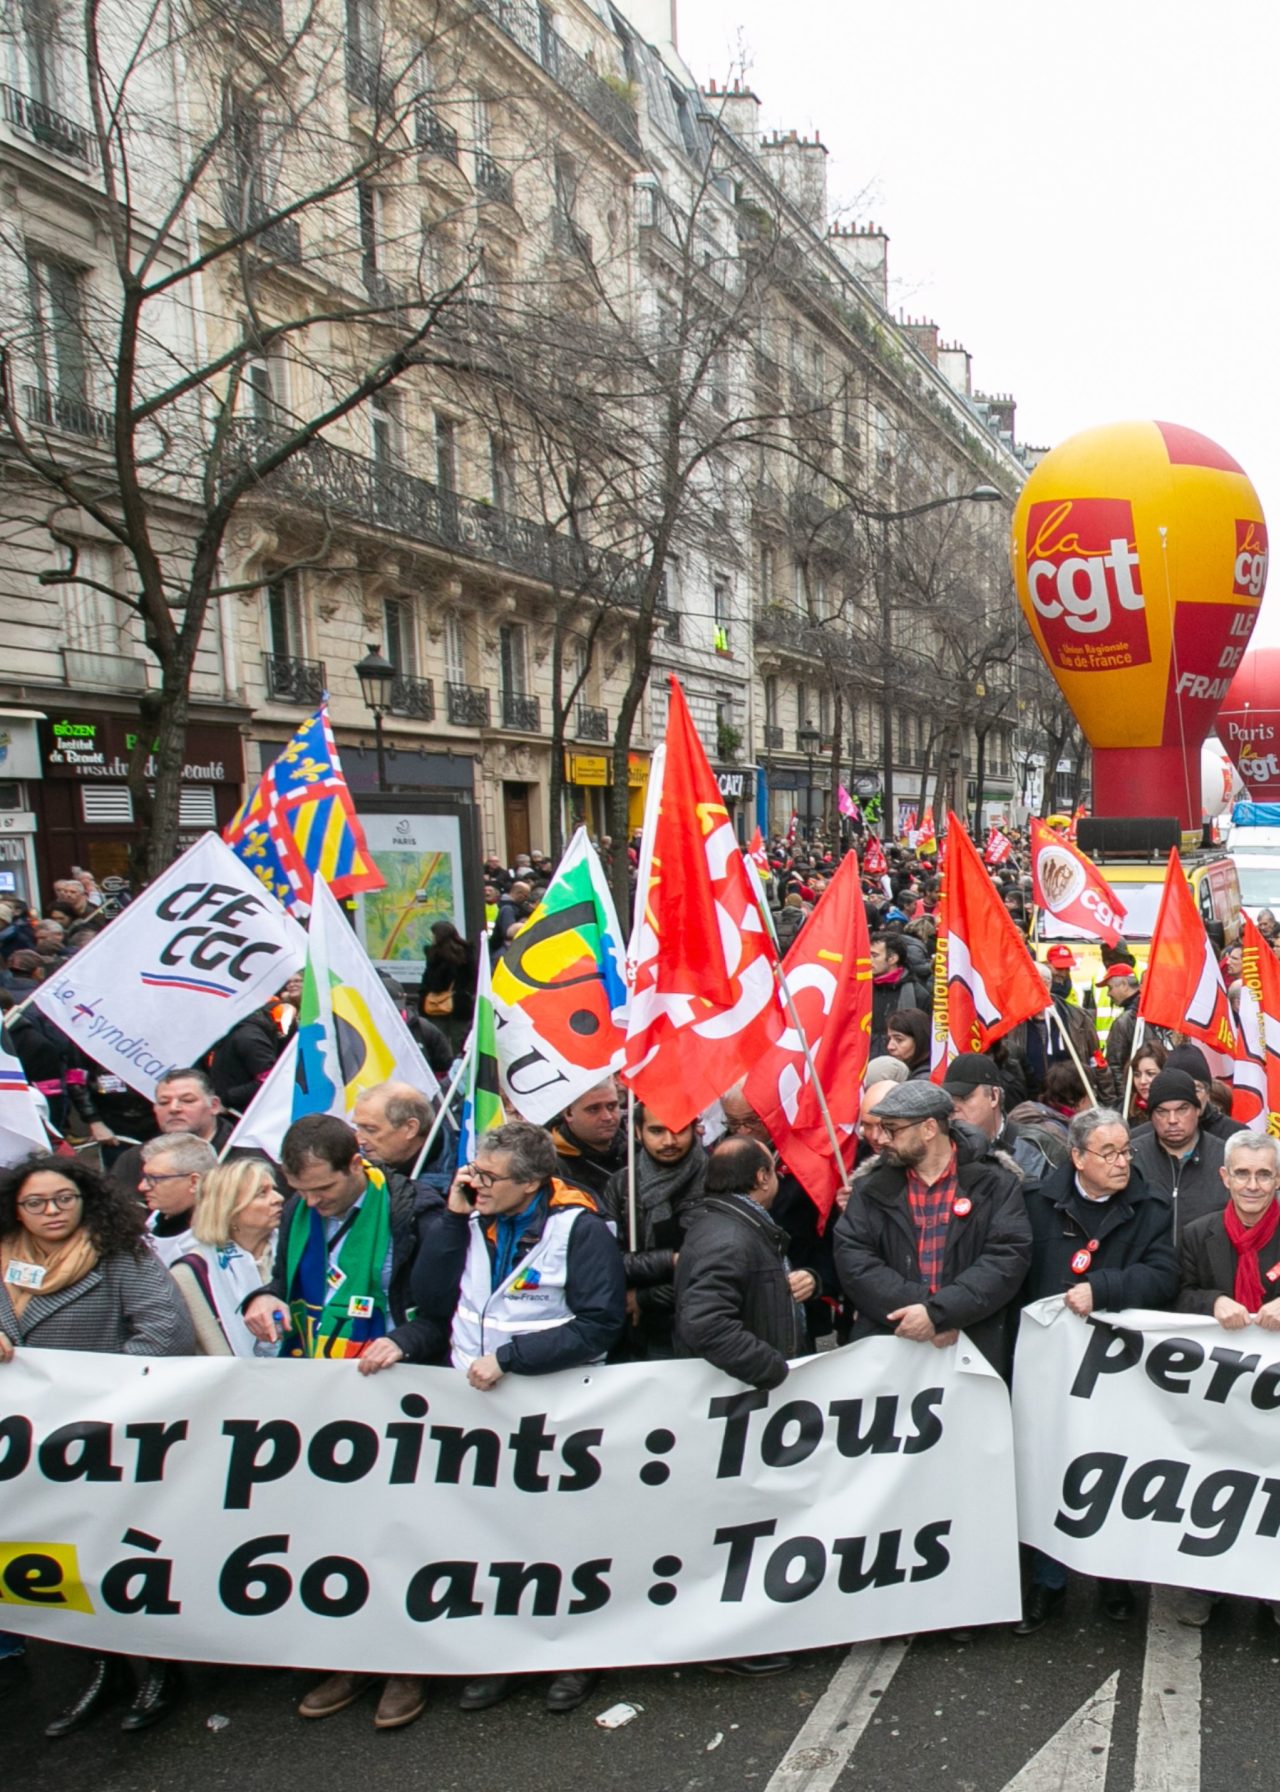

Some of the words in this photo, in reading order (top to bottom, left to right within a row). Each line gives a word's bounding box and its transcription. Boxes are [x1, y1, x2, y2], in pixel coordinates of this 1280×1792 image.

[1027, 500, 1137, 560] la
[1027, 538, 1146, 634] cgt
[1230, 612, 1254, 636] ILE
[1218, 646, 1240, 669] DE
[57, 737, 94, 750] Institut
[1229, 722, 1275, 741] Paris
[49, 750, 64, 763] de
[1238, 752, 1280, 782] cgt
[392, 837, 417, 846] PARIS
[156, 882, 272, 929] CFE
[159, 926, 282, 983] CGC
[221, 1393, 605, 1511] points
[707, 1386, 945, 1480] Tous
[101, 1527, 182, 1616] à
[218, 1533, 371, 1619] 60
[404, 1557, 614, 1623] ans
[713, 1517, 952, 1604] Tous
